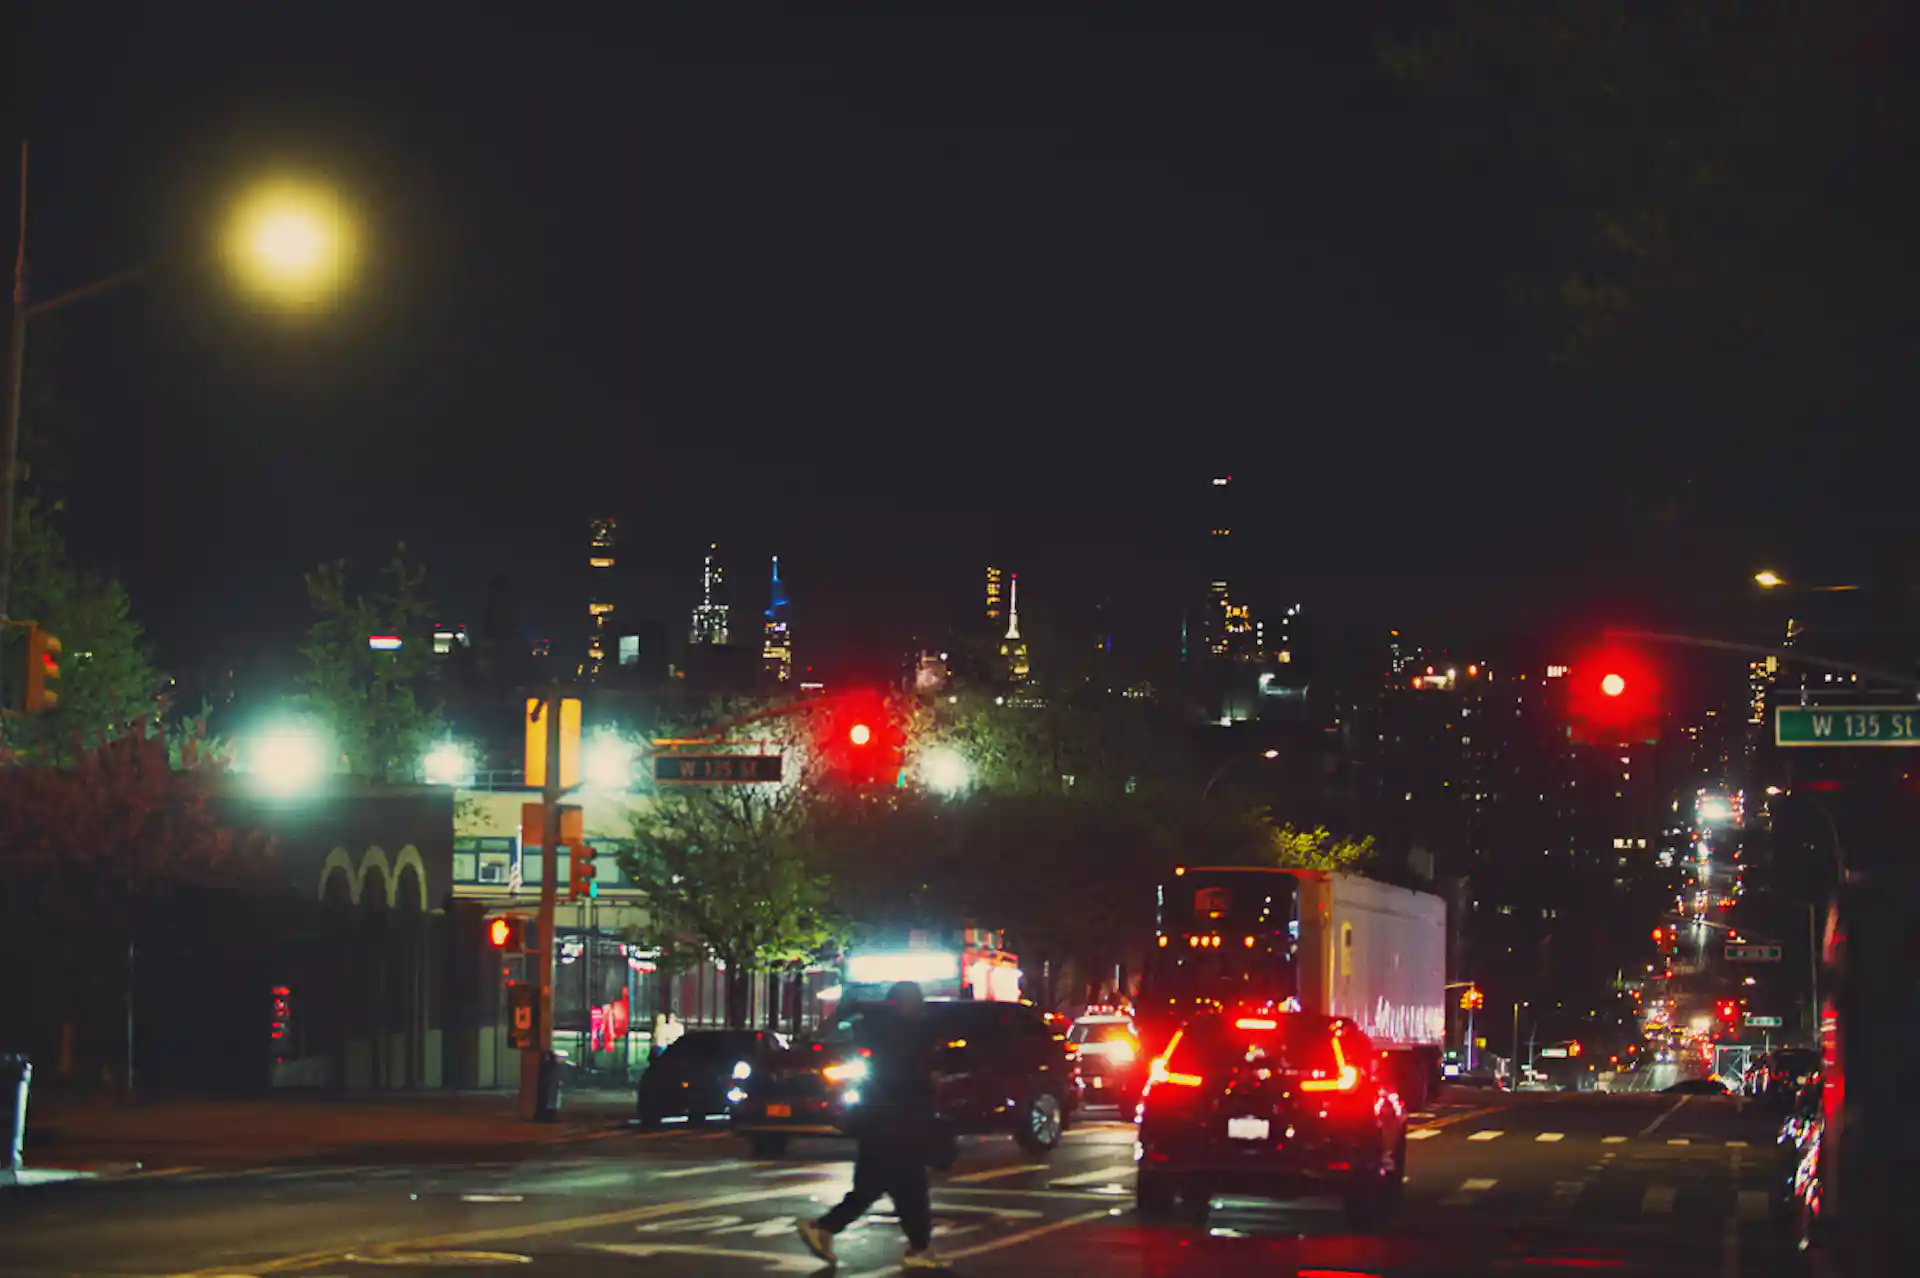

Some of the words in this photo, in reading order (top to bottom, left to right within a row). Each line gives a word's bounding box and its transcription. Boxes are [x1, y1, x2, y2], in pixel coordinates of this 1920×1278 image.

[1812, 714, 1832, 737] W
[1844, 714, 1880, 737] 135
[1891, 713, 1913, 737] St
[679, 760, 697, 777] W
